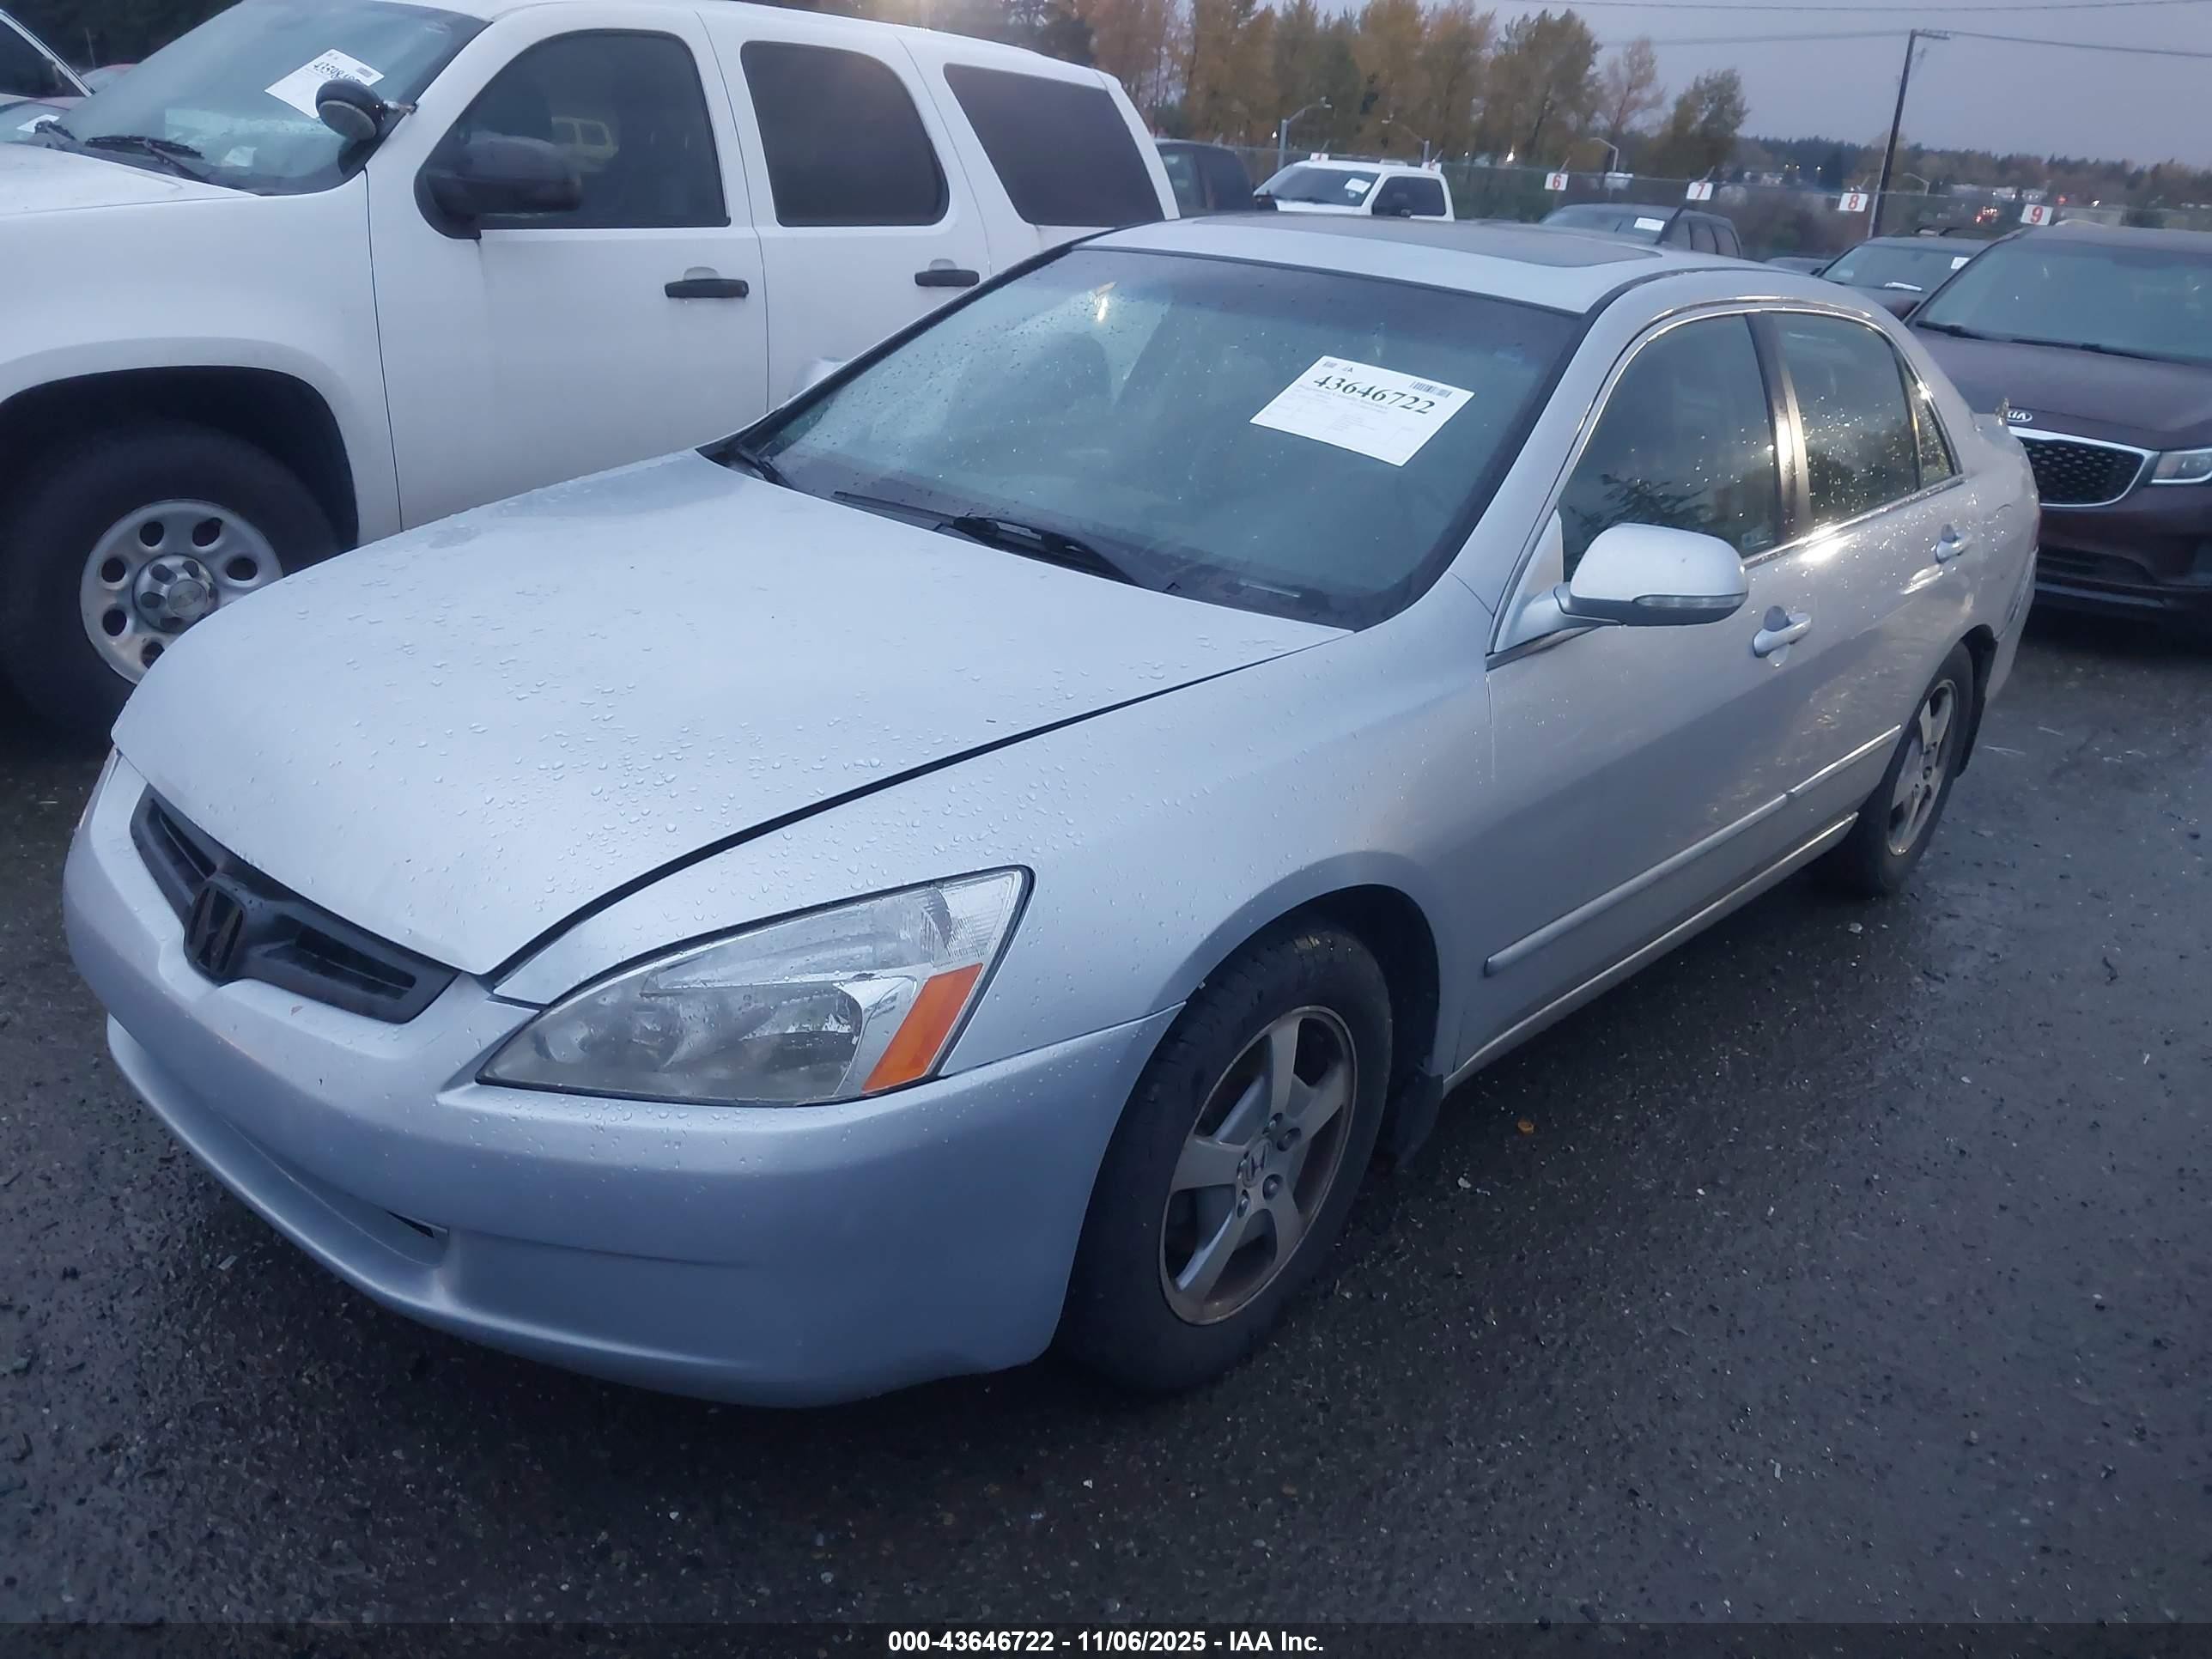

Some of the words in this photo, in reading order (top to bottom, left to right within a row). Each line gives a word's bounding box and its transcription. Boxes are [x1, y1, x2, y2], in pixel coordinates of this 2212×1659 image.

[1552, 174, 1562, 189] 6
[1696, 183, 1706, 198] 7
[1847, 194, 1860, 210] 8
[2030, 206, 2044, 223] 9
[1313, 375, 1436, 415] 43646722
